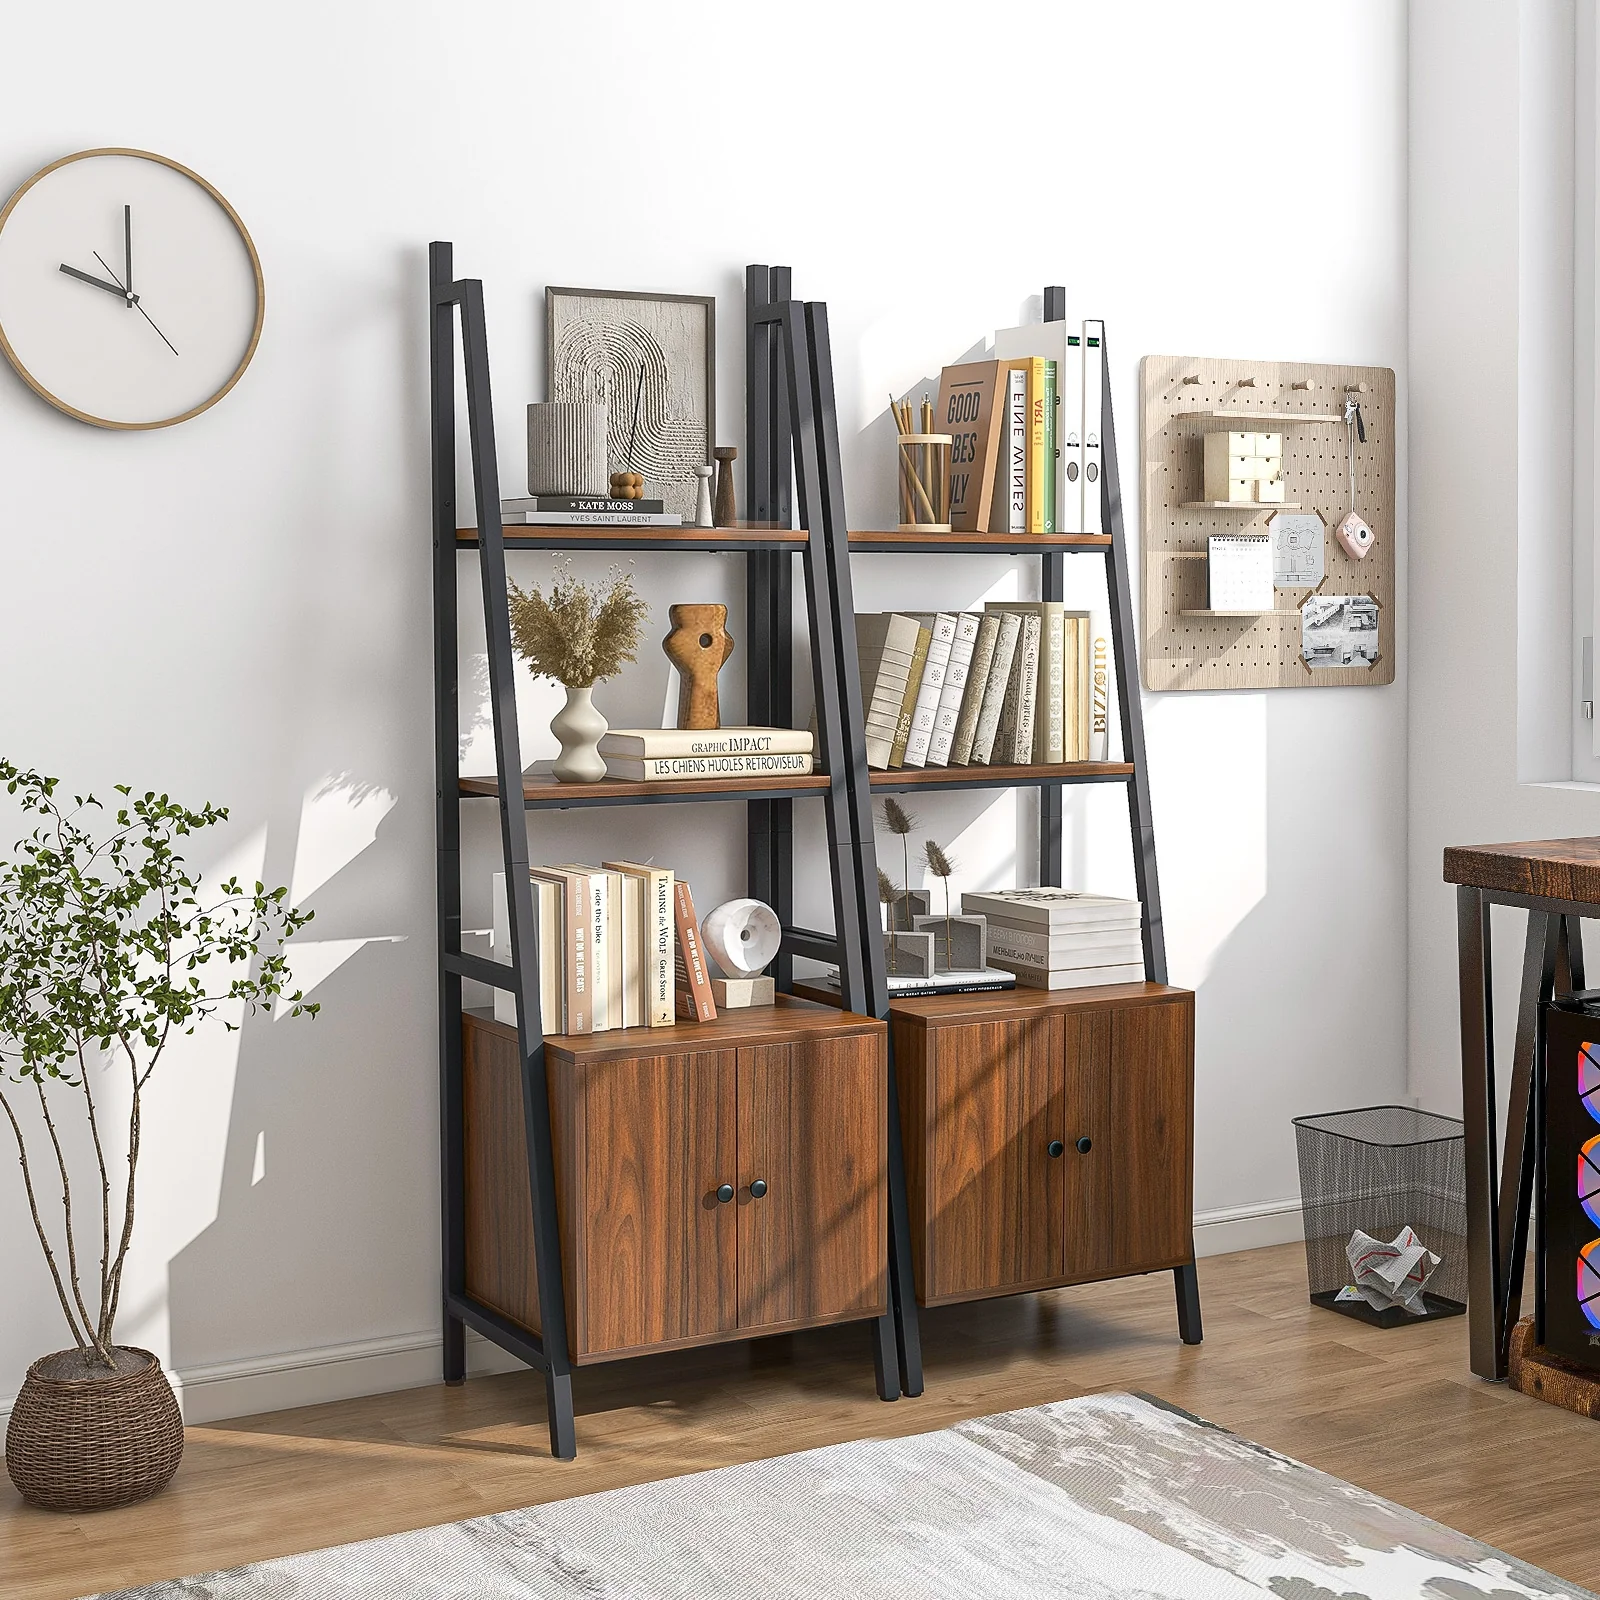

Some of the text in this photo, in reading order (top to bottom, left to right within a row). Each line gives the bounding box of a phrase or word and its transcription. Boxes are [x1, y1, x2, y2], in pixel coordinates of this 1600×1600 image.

[947, 392, 981, 425] GOOD
[952, 432, 977, 463] BES
[950, 473, 970, 504] NLY
[578, 501, 634, 511] KATE MOSS
[617, 515, 651, 523] LAURENT
[691, 737, 772, 753] GRAPHIC IMPACT
[654, 755, 804, 774] LES CHIENS HUOLES RETROVISEUR
[658, 876, 668, 1001] TAMING the WOLF GREG STONE
[575, 928, 584, 993] WHY DO WE LOVE CATS
[686, 928, 705, 985] WHY DO WE LOVE CATS
[1025, 953, 1044, 965] ЛУЧШЕ
